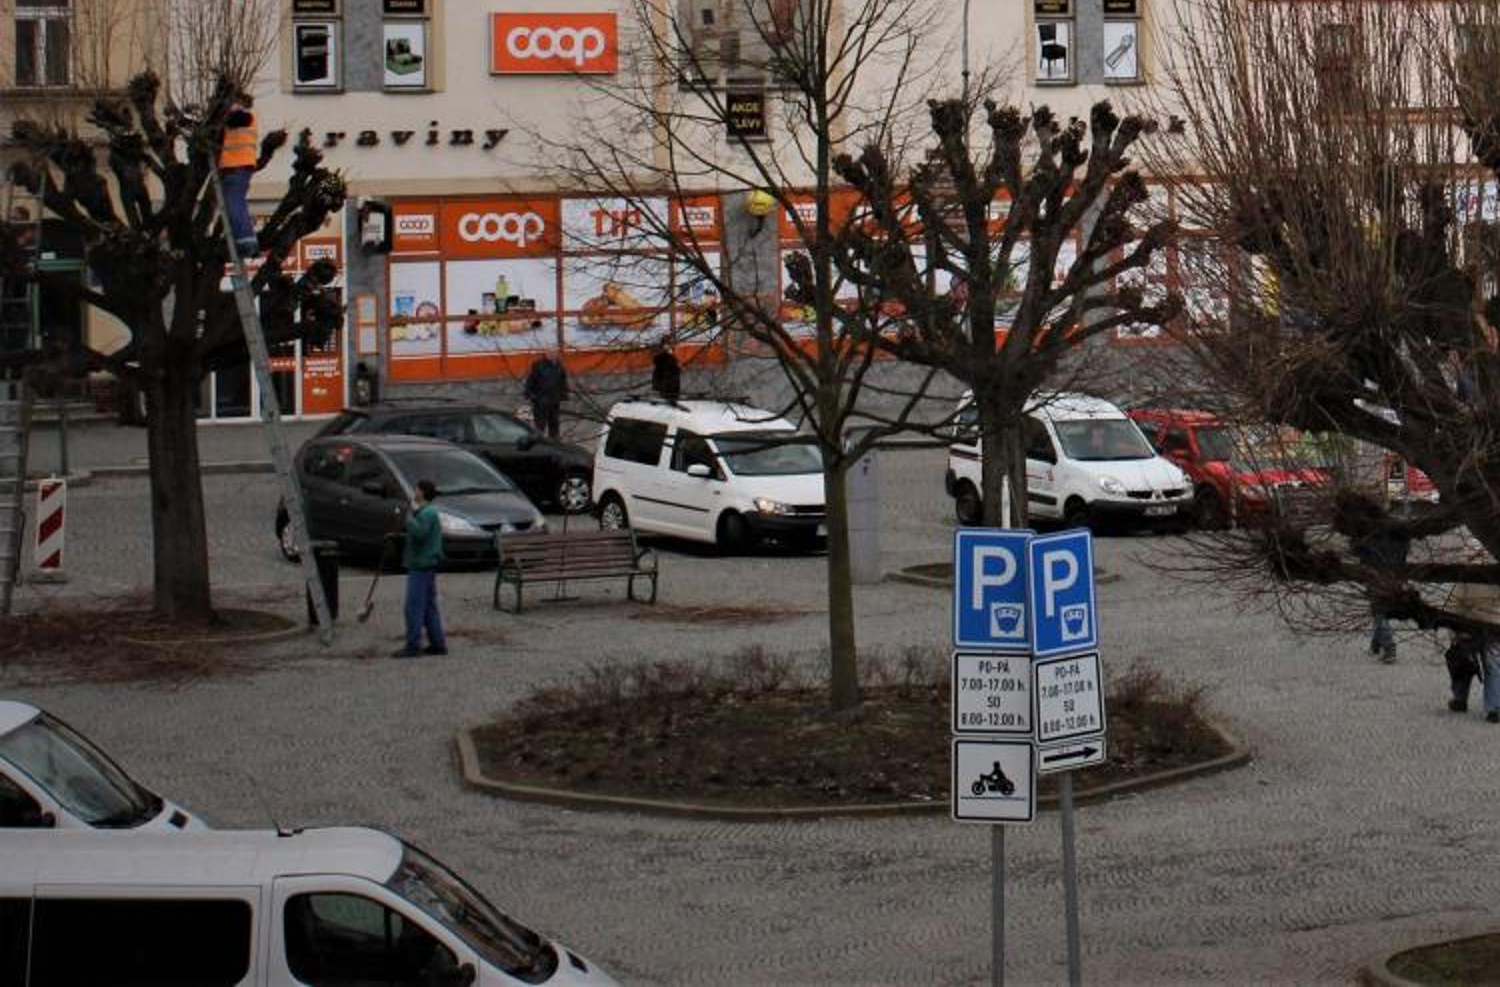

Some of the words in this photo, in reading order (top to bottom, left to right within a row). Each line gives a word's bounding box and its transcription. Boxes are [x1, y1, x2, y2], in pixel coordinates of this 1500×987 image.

[507, 25, 605, 65] coop
[458, 211, 545, 249] coop
[973, 544, 1017, 610] P
[1043, 549, 1079, 618] P
